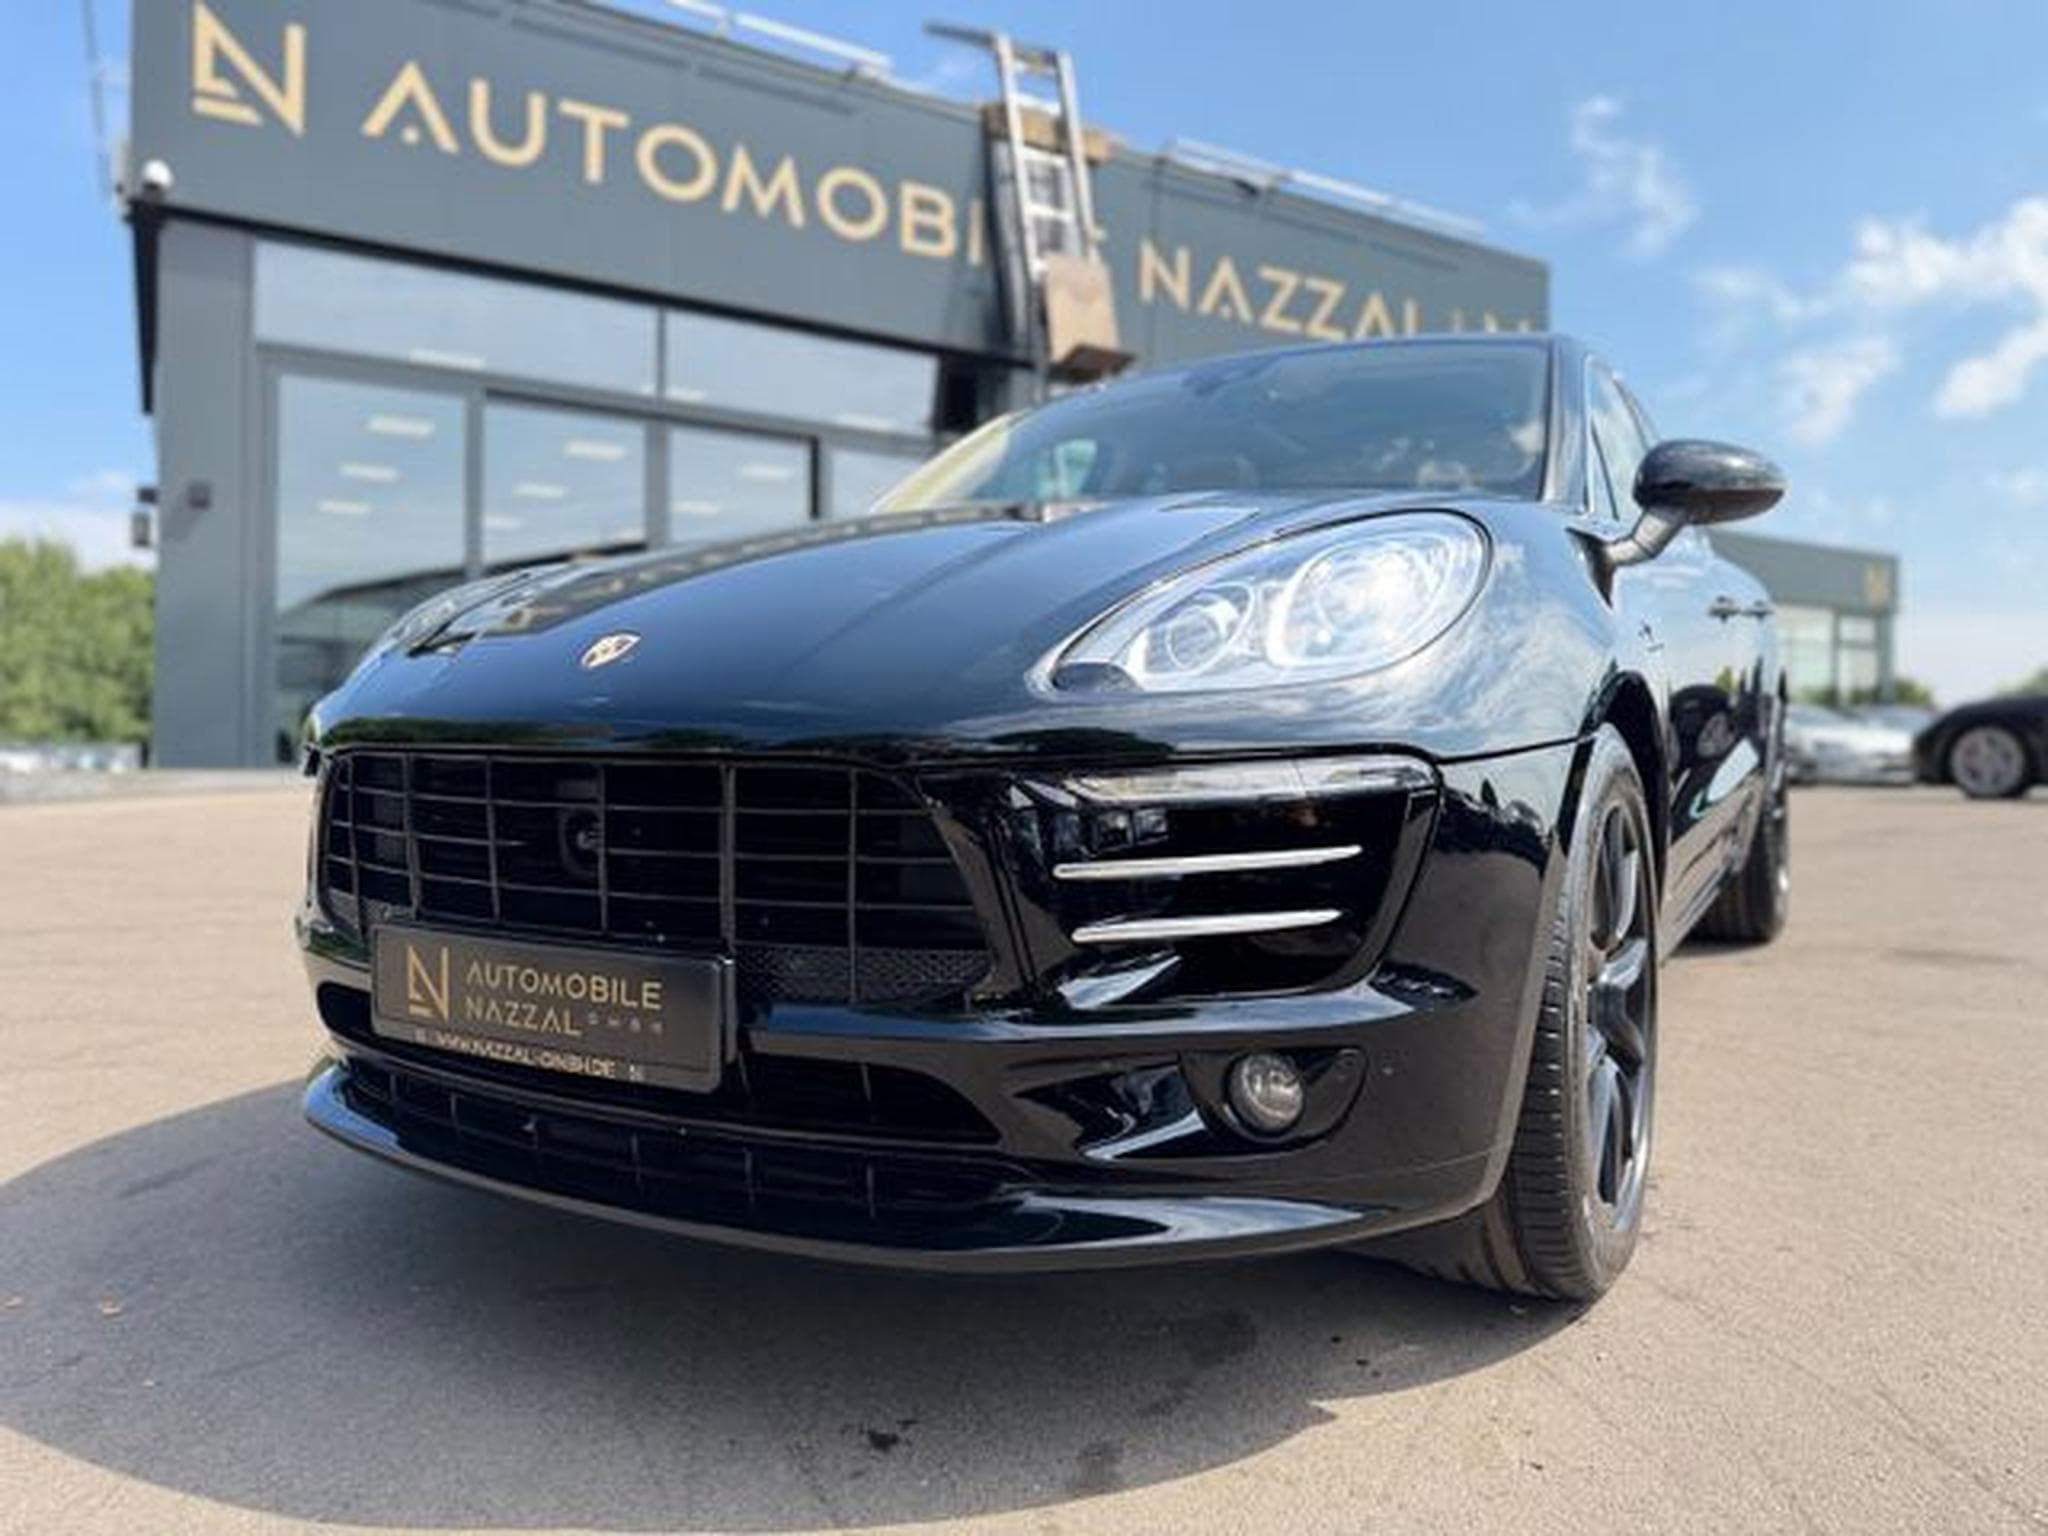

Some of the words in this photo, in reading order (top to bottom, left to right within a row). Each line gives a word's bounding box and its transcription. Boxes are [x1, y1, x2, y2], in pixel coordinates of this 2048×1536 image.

[361, 60, 1107, 267] AUTOMOBI
[465, 960, 662, 1011] AUTOMOBILE
[465, 995, 583, 1038] NAZZAL
